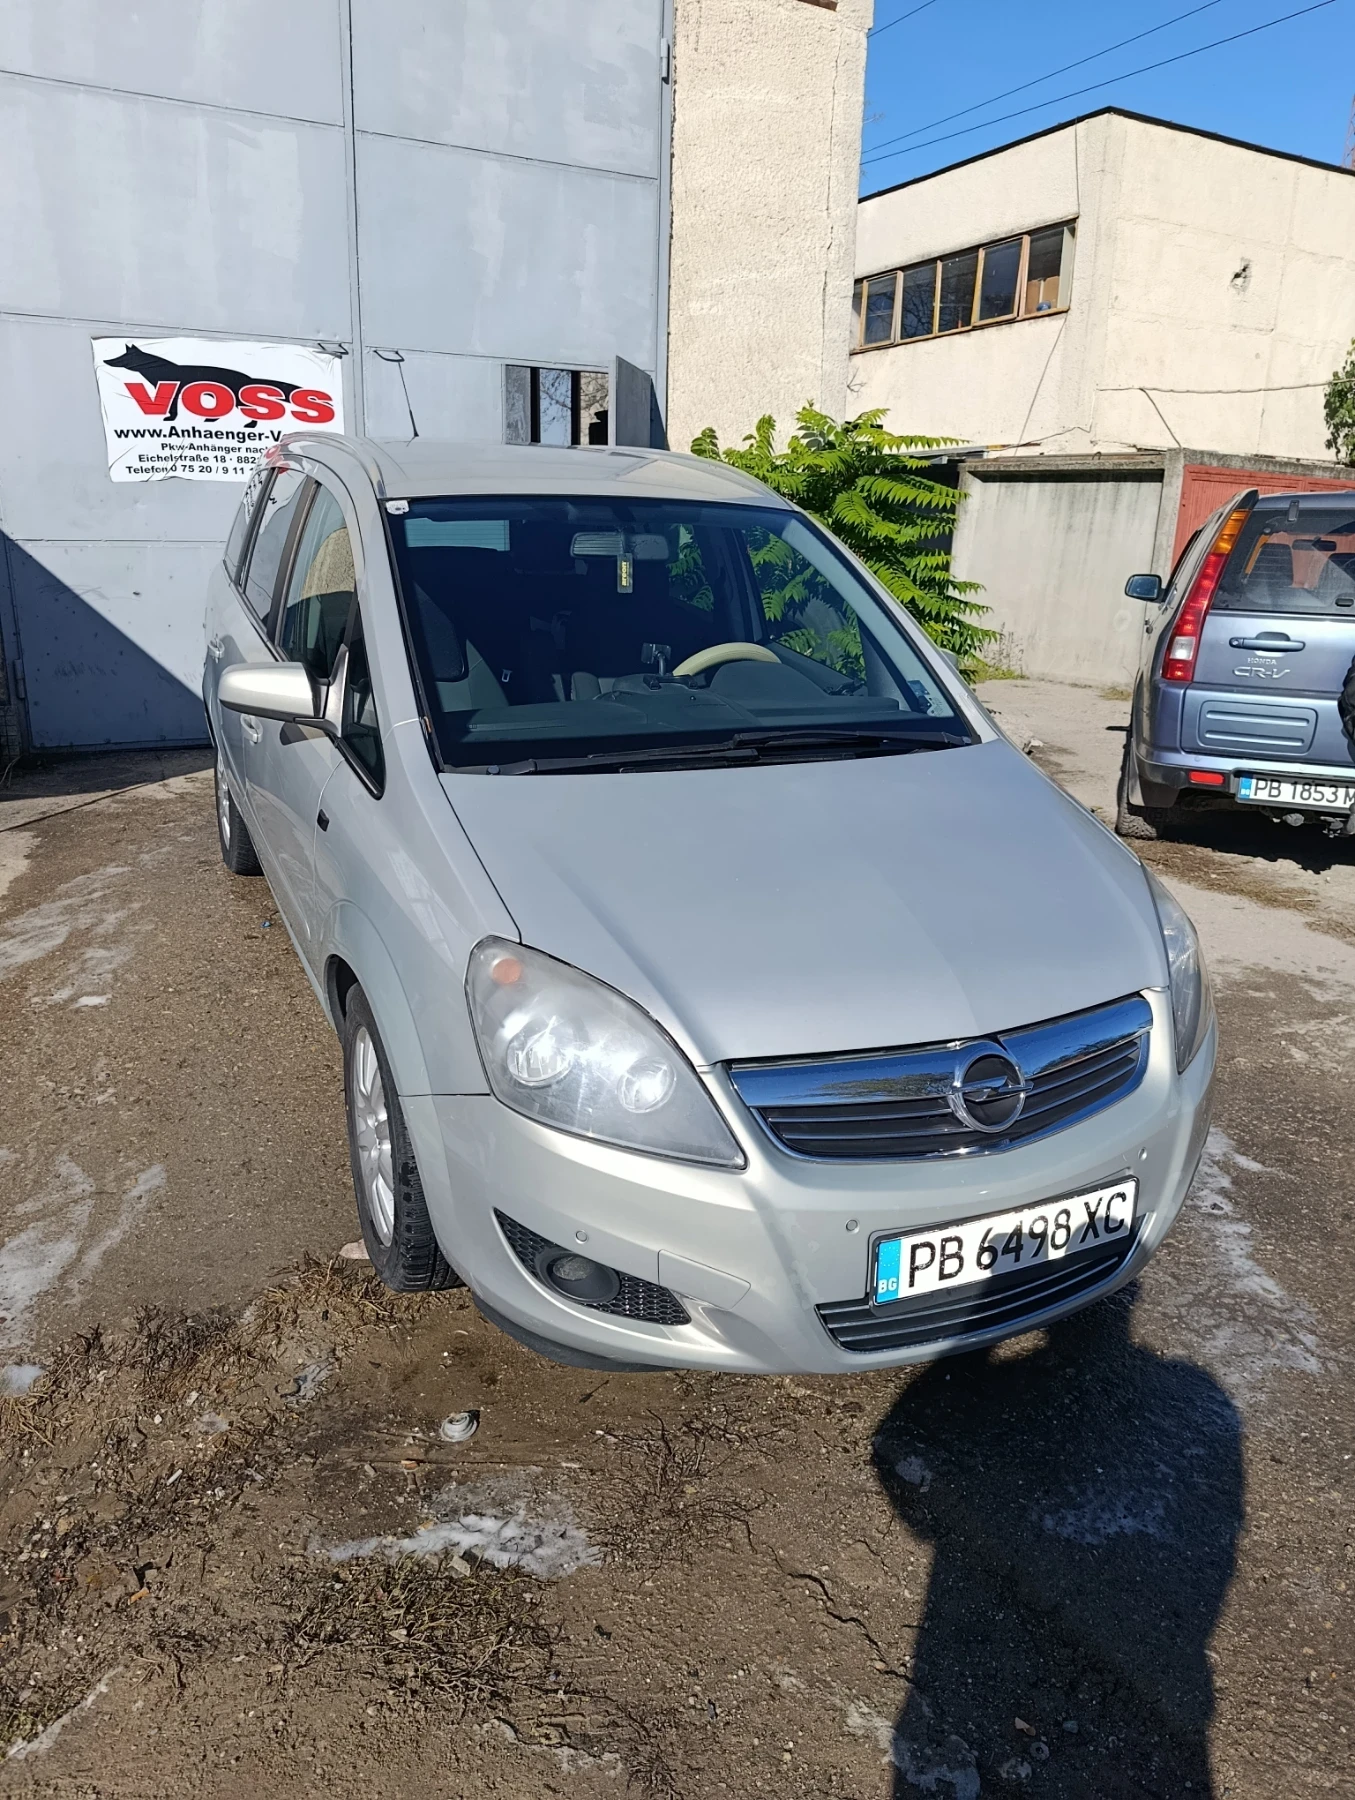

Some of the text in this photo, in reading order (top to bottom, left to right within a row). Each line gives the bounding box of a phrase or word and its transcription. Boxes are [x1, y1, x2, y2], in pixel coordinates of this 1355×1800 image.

[124, 381, 335, 423] VOSS
[114, 425, 282, 443] www.Anhaenger-V
[161, 442, 268, 454] Pkw-Anhänger nac
[138, 453, 209, 463] Eichelstraße
[213, 454, 226, 463] 18
[236, 455, 260, 464] 882
[125, 465, 168, 474] Telefon
[170, 464, 177, 472] 0
[181, 464, 195, 473] 75
[198, 465, 212, 473] 20
[222, 466, 229, 475] 9
[232, 467, 245, 475] 11
[1247, 657, 1277, 665] HONDA
[1232, 666, 1291, 679] CR-V
[1254, 778, 1282, 798] PB
[1290, 780, 1339, 804] 1853
[908, 1191, 1127, 1288] PB 6498 XC
[878, 1279, 897, 1293] BG
